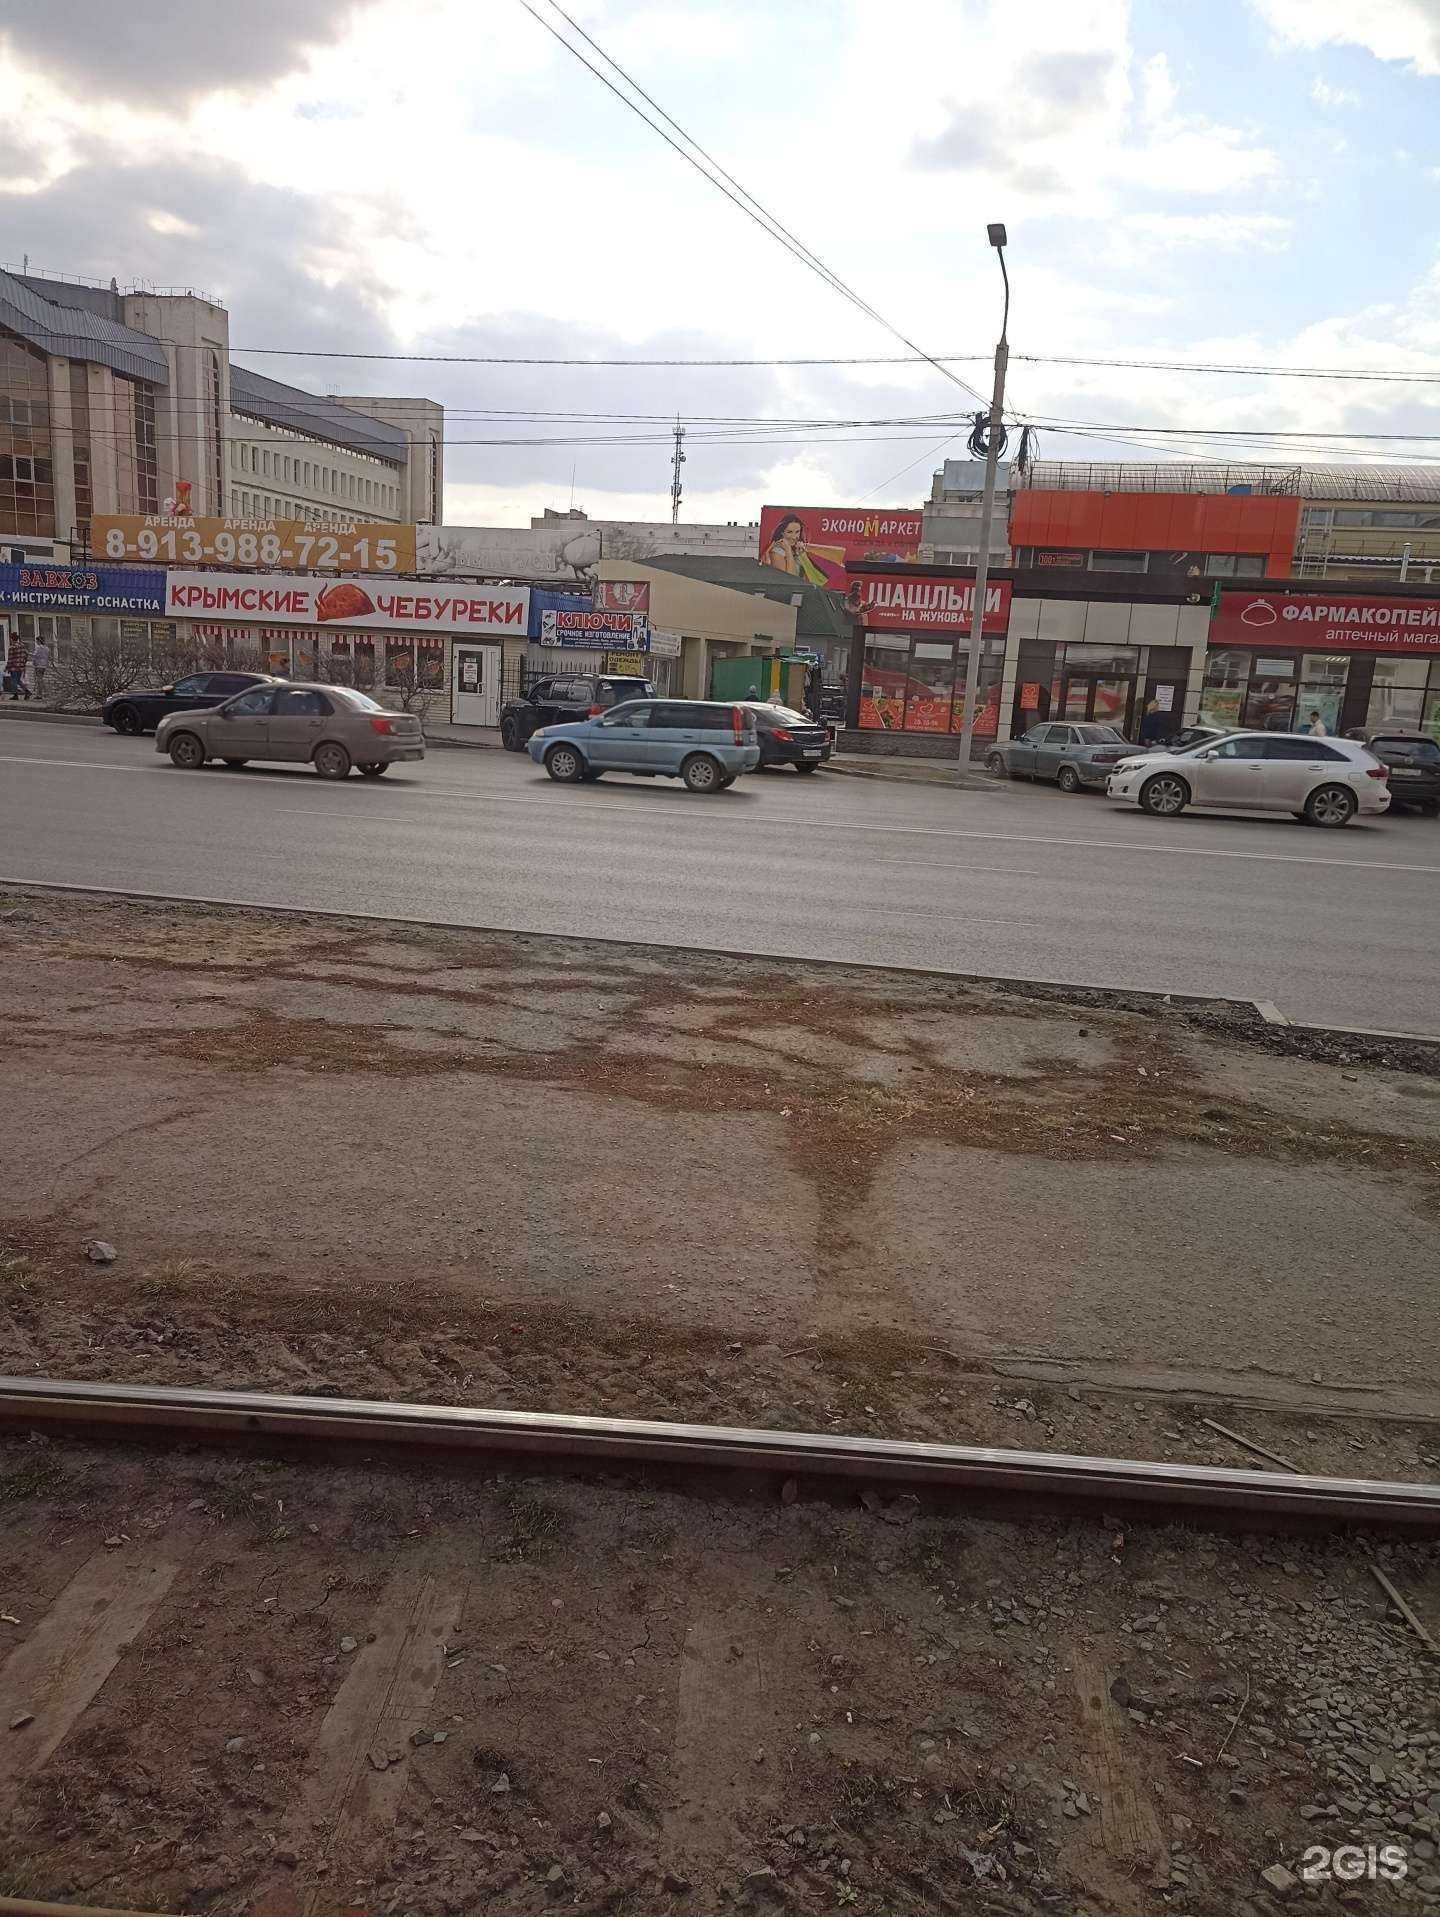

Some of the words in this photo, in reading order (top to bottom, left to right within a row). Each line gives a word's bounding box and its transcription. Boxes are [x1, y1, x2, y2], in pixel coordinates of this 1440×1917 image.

[144, 515, 196, 529] АРЕНДА
[223, 519, 277, 533] АРЕНДА
[303, 522, 358, 536] АРЕНДА
[821, 515, 921, 537] ЭКОНОМАРКЕТ
[106, 528, 398, 570] 8-913-988-72-15
[19, 569, 98, 590] ЗАВХОЗ
[12, 591, 90, 606] ИНСТРУМЕНТ
[97, 596, 160, 610] ОСНАСТКА
[171, 584, 310, 613] КРЫМСКИЕ
[868, 582, 1002, 613] ШАШЛЫИ
[377, 594, 524, 625] ЧЕБУРЕКИ
[901, 609, 916, 622] НА
[919, 610, 965, 624] ЖУКОВА
[1282, 604, 1440, 627] ФАРМАКОПЕЙ
[556, 611, 633, 632] КЛЮЧИ
[556, 630, 583, 638] СРОЧНОЕ
[584, 631, 631, 640] ИЗГОТОВЛЕНИЕ
[1326, 629, 1399, 642] аптечный
[1403, 631, 1440, 644] мага
